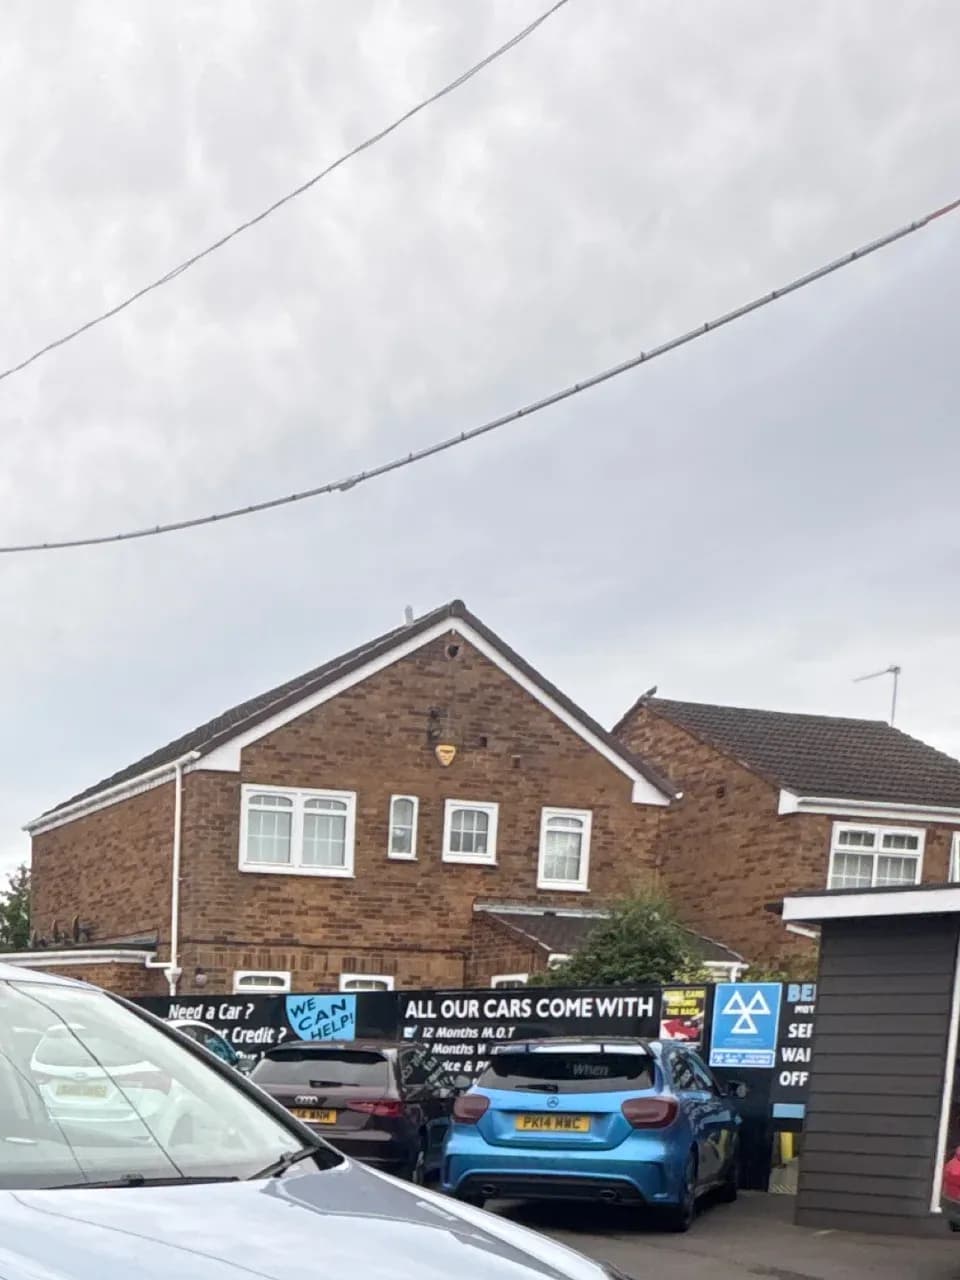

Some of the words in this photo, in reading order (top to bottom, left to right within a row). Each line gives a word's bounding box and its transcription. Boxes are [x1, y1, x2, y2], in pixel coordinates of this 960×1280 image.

[168, 1003, 202, 1019] Need
[205, 1007, 215, 1019] a
[218, 1003, 242, 1020] Car
[290, 997, 316, 1018] WE
[298, 998, 347, 1031] CAN
[404, 999, 437, 1018] ALL
[440, 999, 479, 1018] OUR
[483, 998, 532, 1018] CARS
[535, 997, 593, 1019] COME
[595, 995, 654, 1018] WITH
[231, 1026, 275, 1044] Credit
[310, 1013, 355, 1041] HELP!
[422, 1027, 434, 1039] 12
[435, 1026, 479, 1039] Months
[431, 1043, 474, 1055] Months
